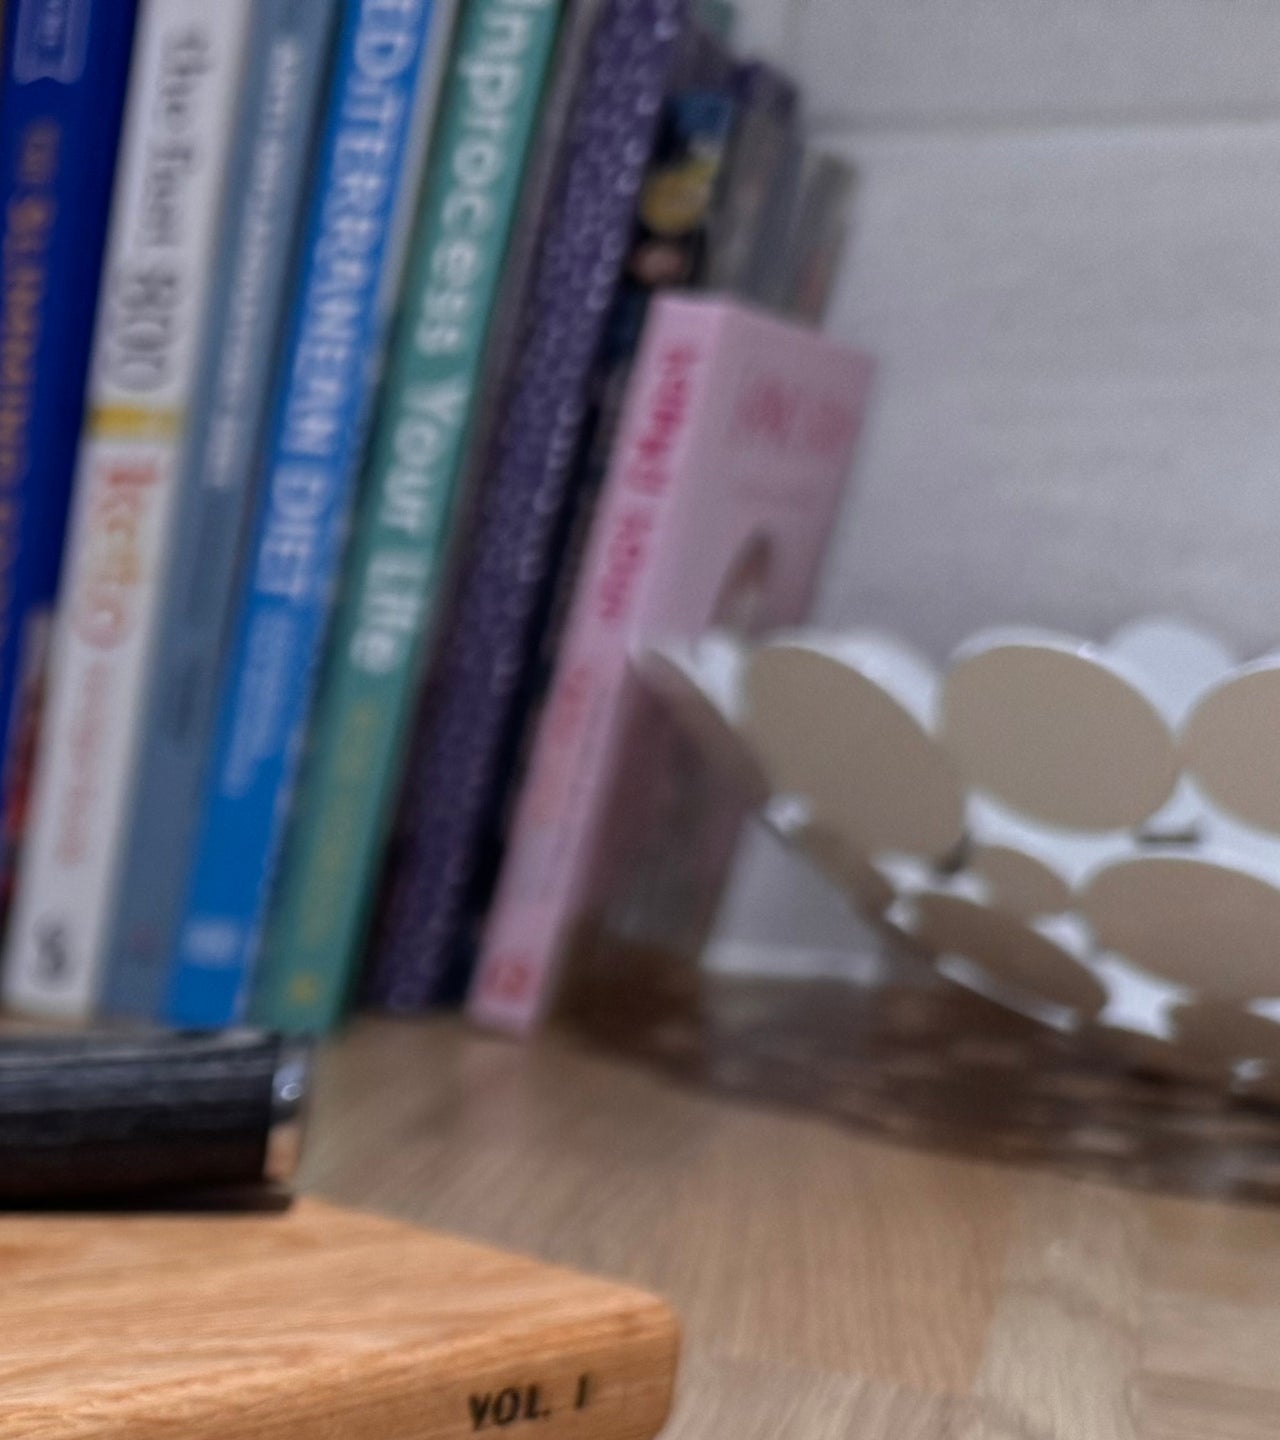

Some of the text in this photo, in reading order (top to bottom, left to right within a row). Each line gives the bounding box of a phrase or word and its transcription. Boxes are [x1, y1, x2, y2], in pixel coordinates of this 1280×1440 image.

[381, 381, 471, 537] Your
[262, 466, 327, 601] DIET
[352, 547, 428, 674] Life
